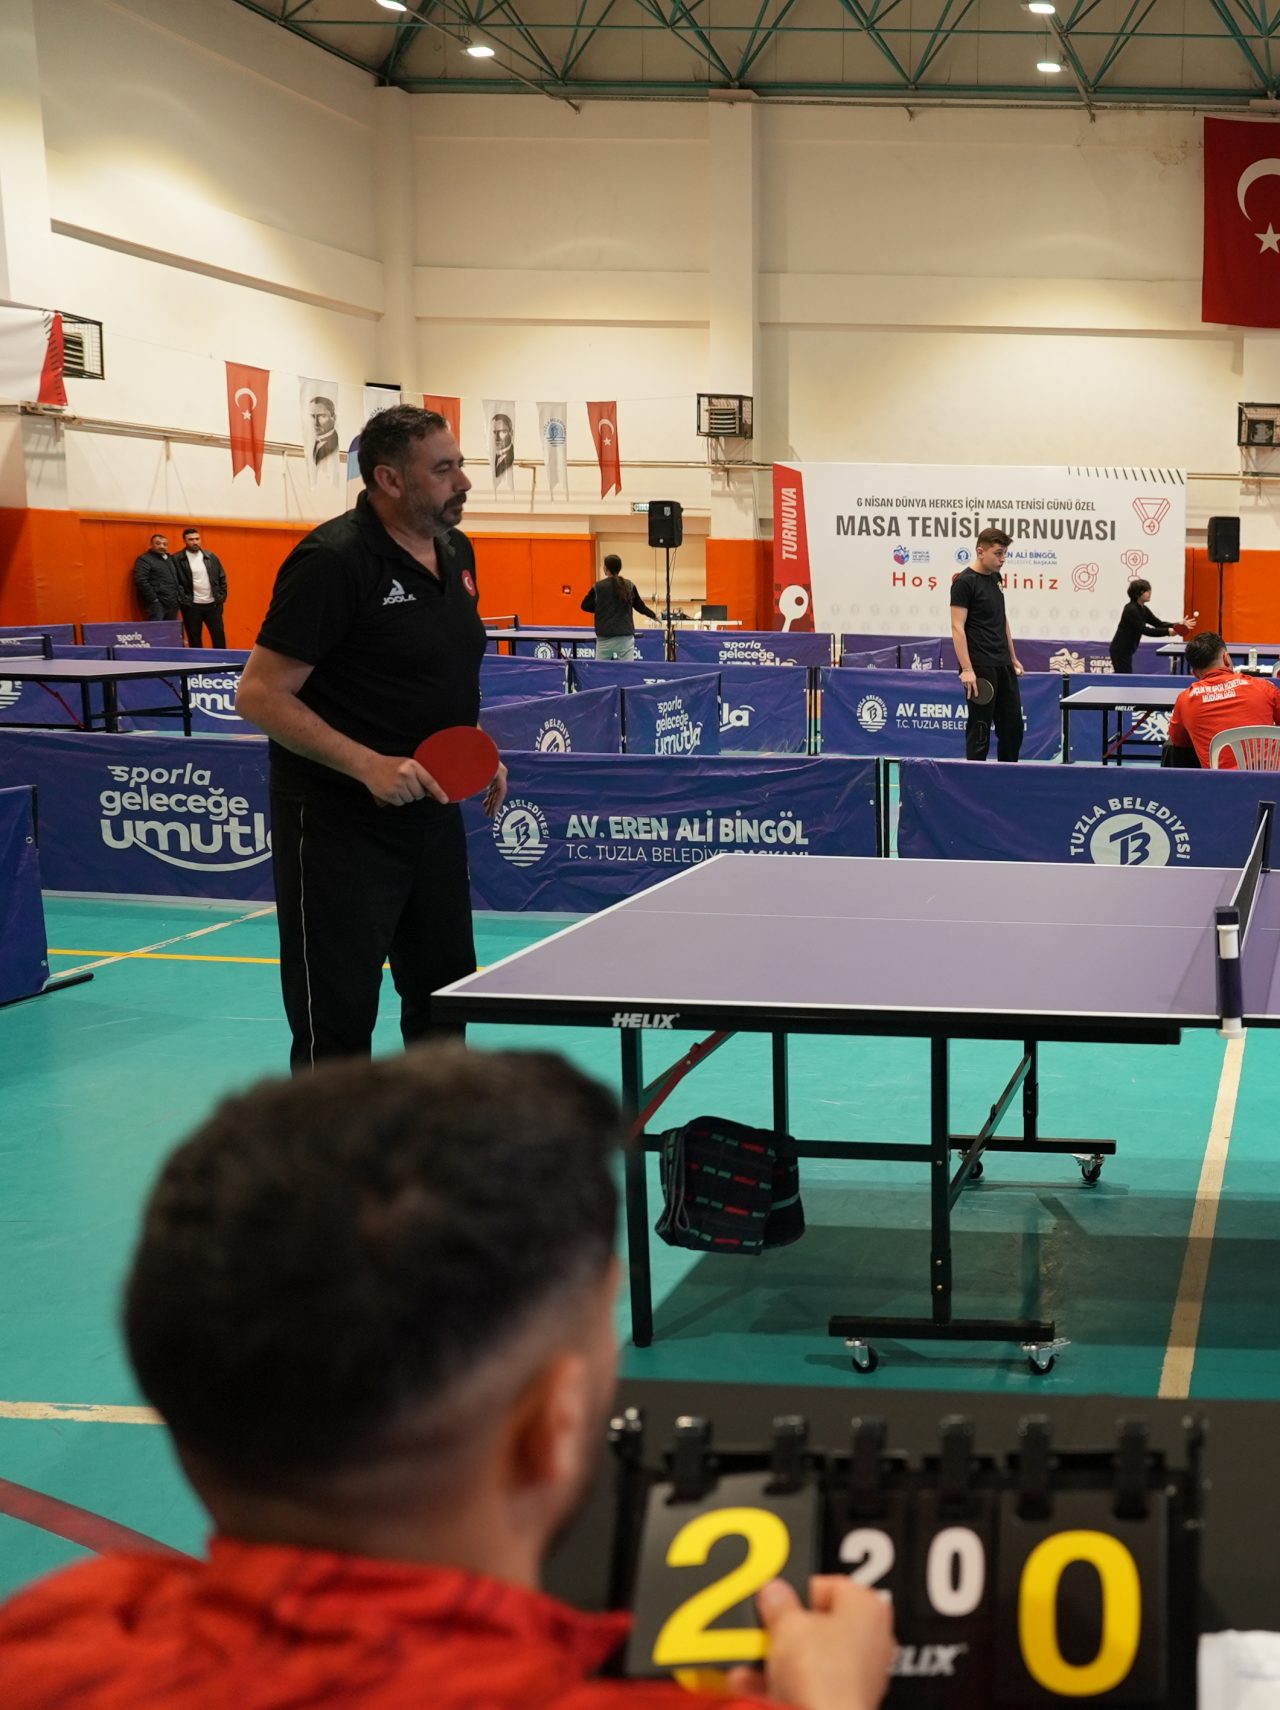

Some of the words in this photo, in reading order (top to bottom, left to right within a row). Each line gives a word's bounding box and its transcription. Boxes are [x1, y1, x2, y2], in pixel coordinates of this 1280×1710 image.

[864, 495, 894, 508] NİSAN
[895, 497, 927, 509] DÜNYA
[928, 498, 964, 509] HERKES
[965, 496, 985, 512] İÇİN
[986, 499, 1014, 510] MASA
[1046, 498, 1072, 511] GÜNÜ
[1075, 498, 1096, 512] ÖZEL
[781, 487, 798, 560] TURNUVA
[835, 513, 901, 537] MASA
[907, 511, 980, 538] TENİSİ
[987, 517, 1116, 541] TURNUVASI
[892, 571, 937, 591] Hoş
[718, 648, 775, 661] geleceğe
[722, 640, 762, 650] sporla
[656, 695, 683, 715] sporla
[895, 703, 917, 718] AV.
[919, 703, 952, 719] EREN
[655, 708, 689, 735] geleceğe
[912, 719, 940, 730] TUZLA
[107, 762, 212, 788] sporla
[99, 784, 250, 821] geleceğe
[100, 812, 273, 857] umutl
[492, 804, 510, 839] TUZLA
[565, 814, 605, 839] AV.
[608, 815, 669, 841] EREN
[674, 809, 713, 843] ALİ
[719, 809, 809, 846] BİNGÖL
[1069, 805, 1107, 856] TUZLA
[1107, 796, 1191, 860] BELEDİYESİ
[565, 844, 592, 860] T.C.
[594, 844, 647, 863] TUZLA
[611, 1012, 675, 1030] HELIX
[838, 1527, 895, 1604] 2
[926, 1526, 986, 1617] 0
[652, 1506, 790, 1666] 2
[1017, 1529, 1142, 1697] 0
